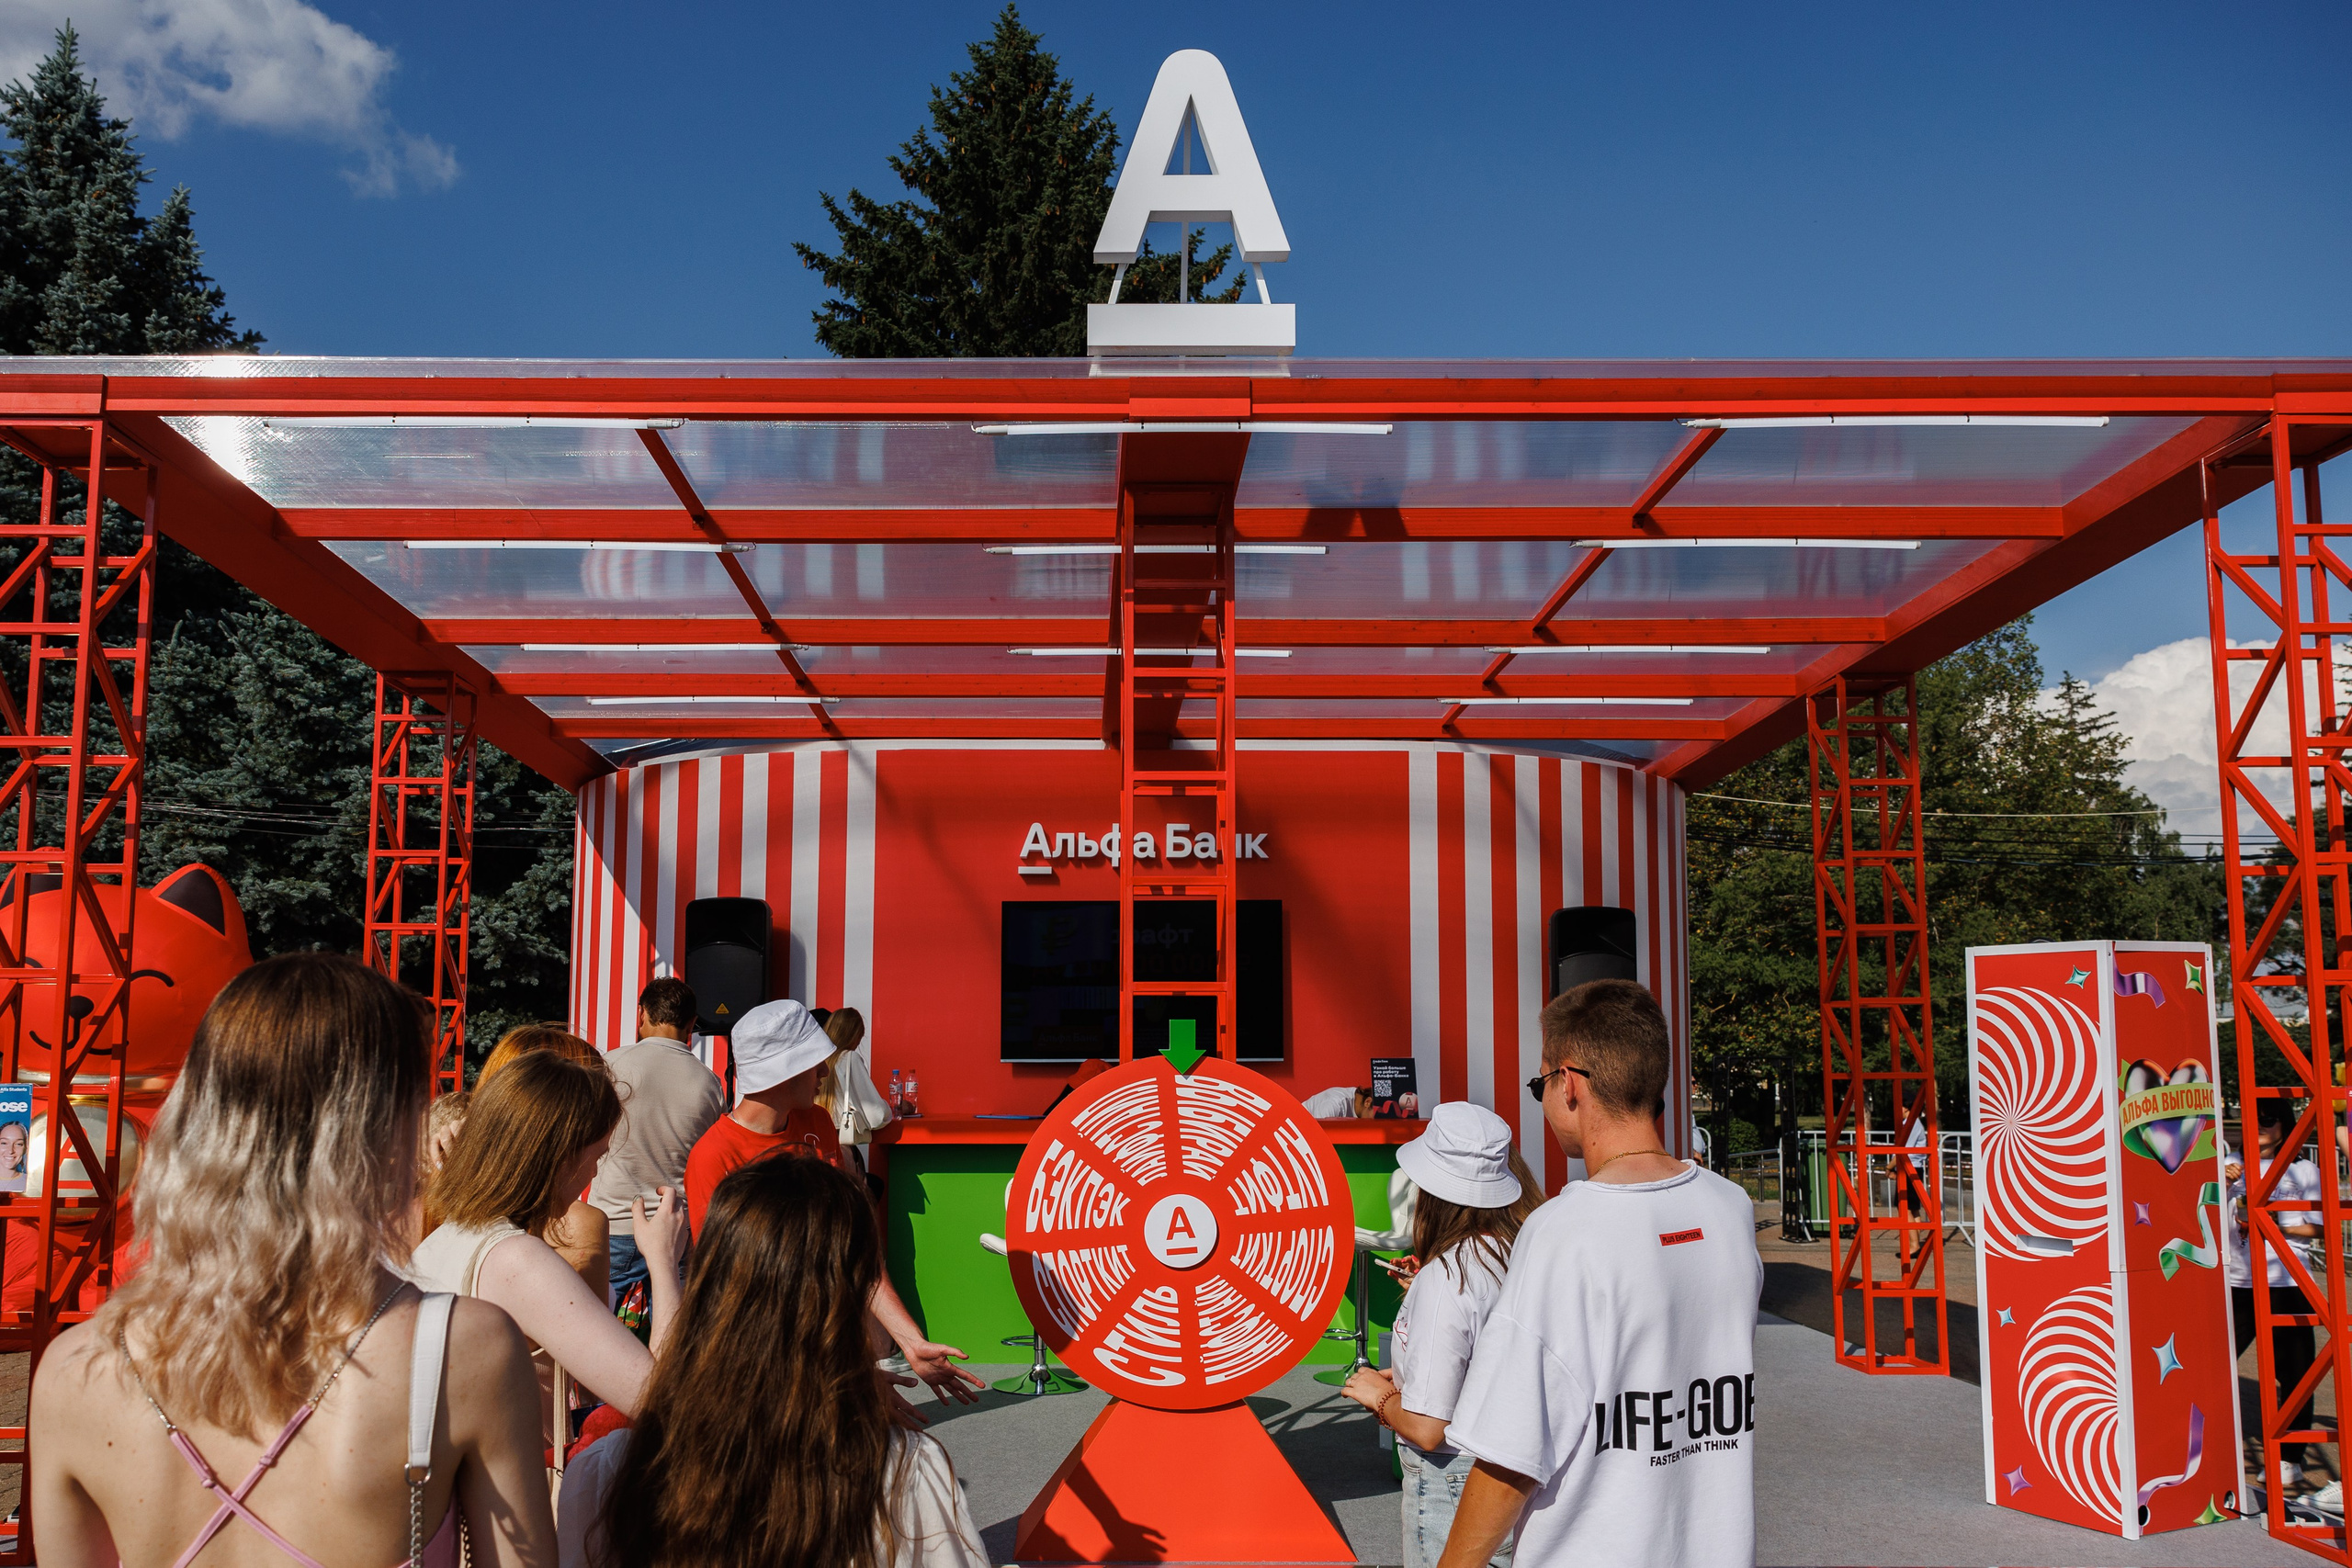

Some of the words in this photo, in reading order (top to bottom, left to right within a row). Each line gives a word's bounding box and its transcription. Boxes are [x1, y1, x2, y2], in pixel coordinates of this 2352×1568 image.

[1018, 822, 1156, 867] Альфа
[1070, 1077, 1167, 1187] ЛАЙФСТАЙЛ
[1175, 1075, 1272, 1181] ВЫБИРАЙ
[2122, 1094, 2159, 1126] АЛЬФА
[1025, 1139, 1131, 1234] БЭКПЭК
[1227, 1117, 1329, 1215] АУТФИТ
[1229, 1224, 1335, 1322] СПОРТКИТ
[1662, 1235, 1675, 1244] PLUS
[1676, 1231, 1701, 1242] EIGHTEEN
[1032, 1244, 1136, 1342] СПОРТКИТ
[1093, 1285, 1186, 1387] СТИЛЬ
[1194, 1274, 1294, 1385] ЛАЙФСТАЙЛ
[1650, 1450, 1680, 1467] FASTER
[1681, 1442, 1702, 1459] THAN
[1704, 1438, 1739, 1451] THINK
